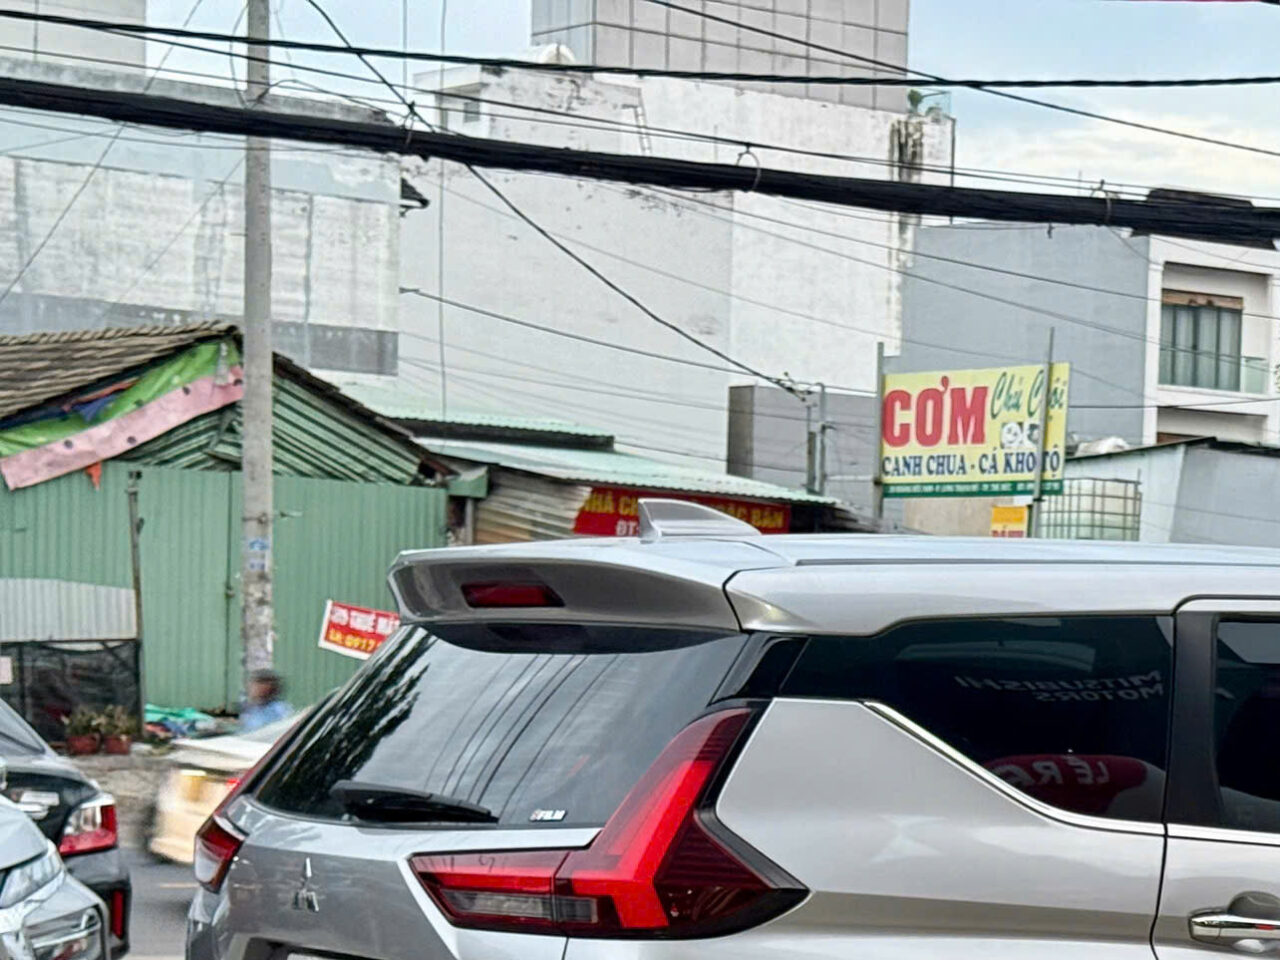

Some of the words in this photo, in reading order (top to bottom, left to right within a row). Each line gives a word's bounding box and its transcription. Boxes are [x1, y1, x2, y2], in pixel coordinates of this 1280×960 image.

[882, 375, 988, 447] CƠM
[882, 455, 922, 477] CANH
[926, 454, 966, 476] CHUA
[978, 446, 998, 474] CÁ
[1003, 451, 1037, 474] KHO
